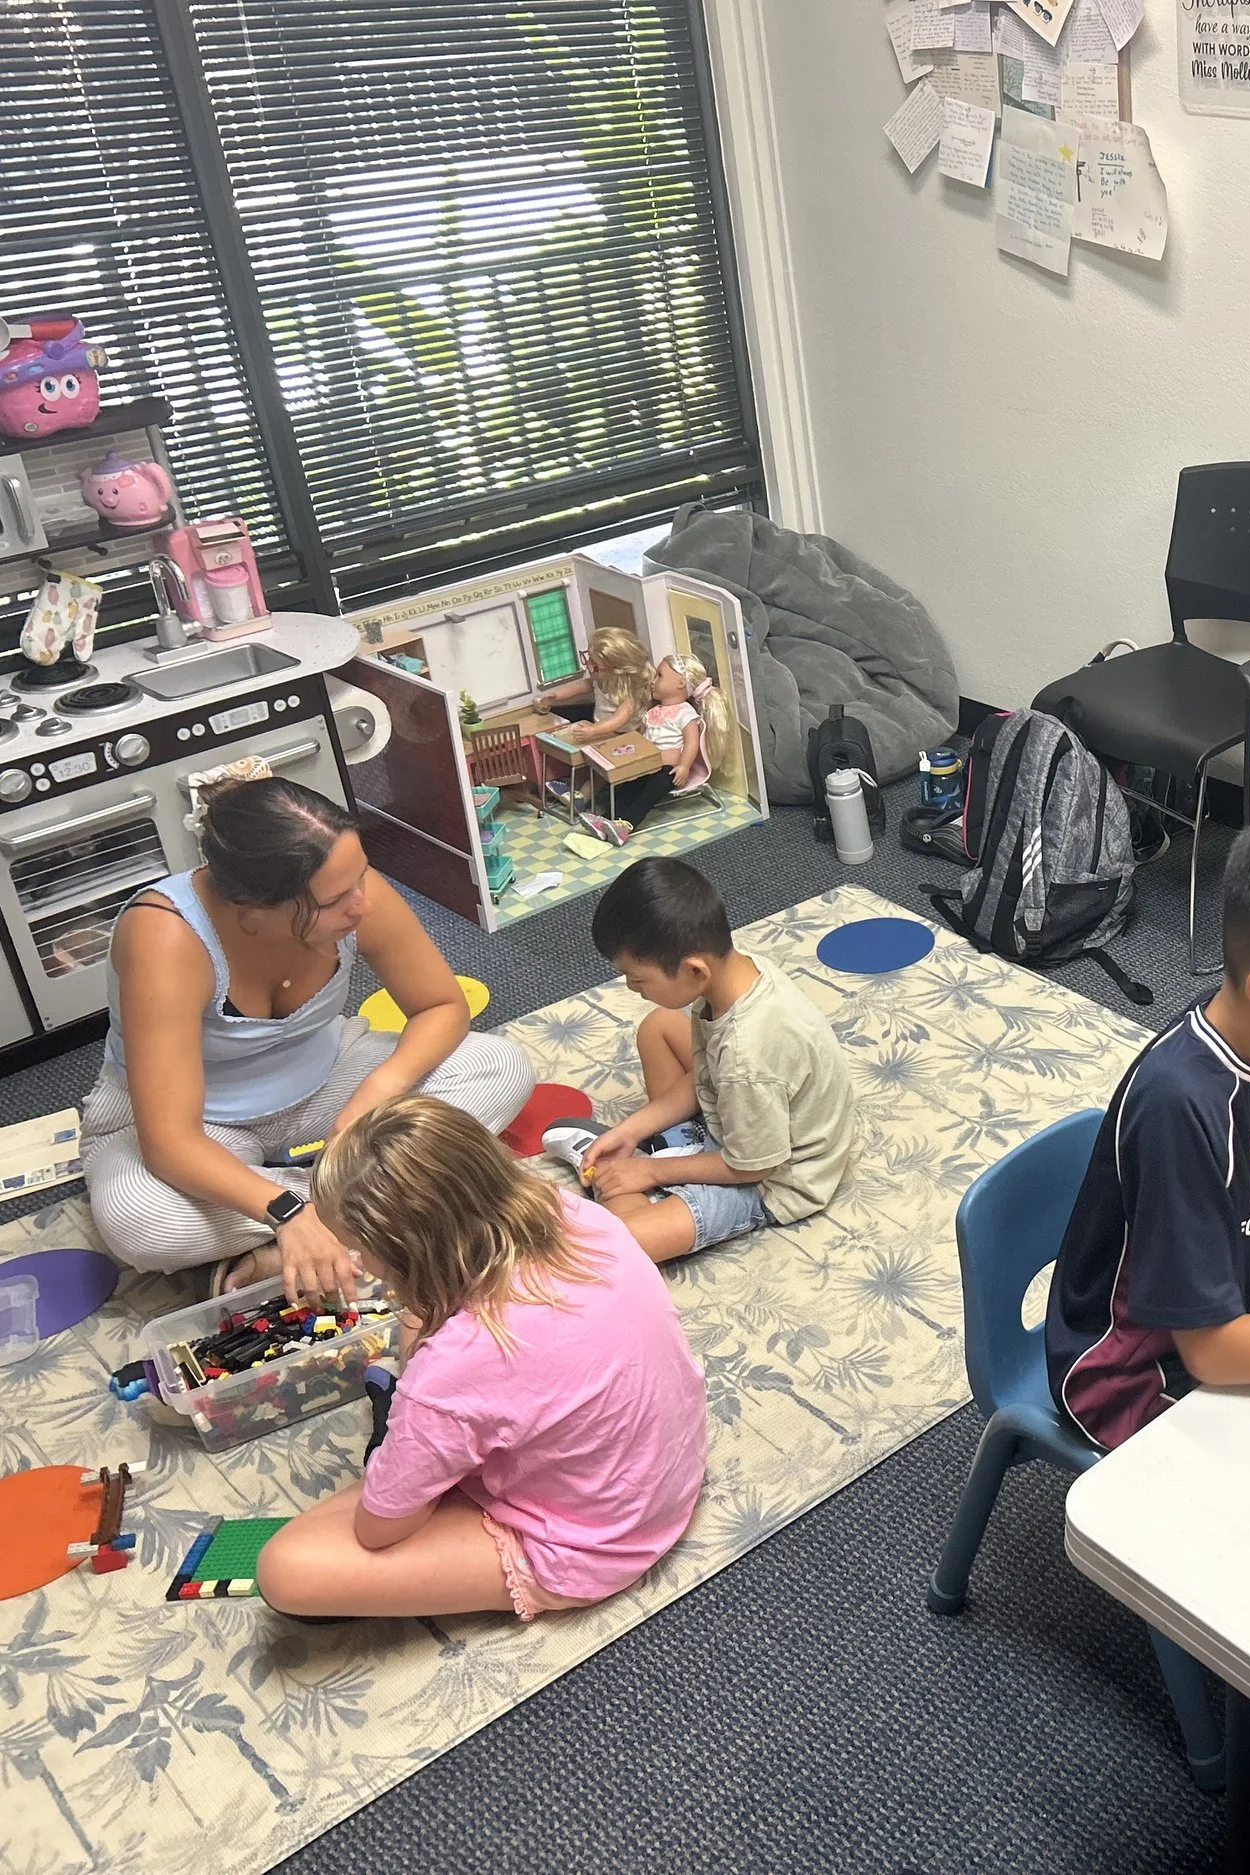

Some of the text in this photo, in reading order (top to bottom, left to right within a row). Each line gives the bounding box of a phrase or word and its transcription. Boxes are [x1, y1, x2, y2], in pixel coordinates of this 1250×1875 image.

[1195, 14, 1218, 34] have
[1221, 23, 1229, 34] a
[1192, 42, 1215, 55] WITH
[1191, 60, 1217, 78] Miss
